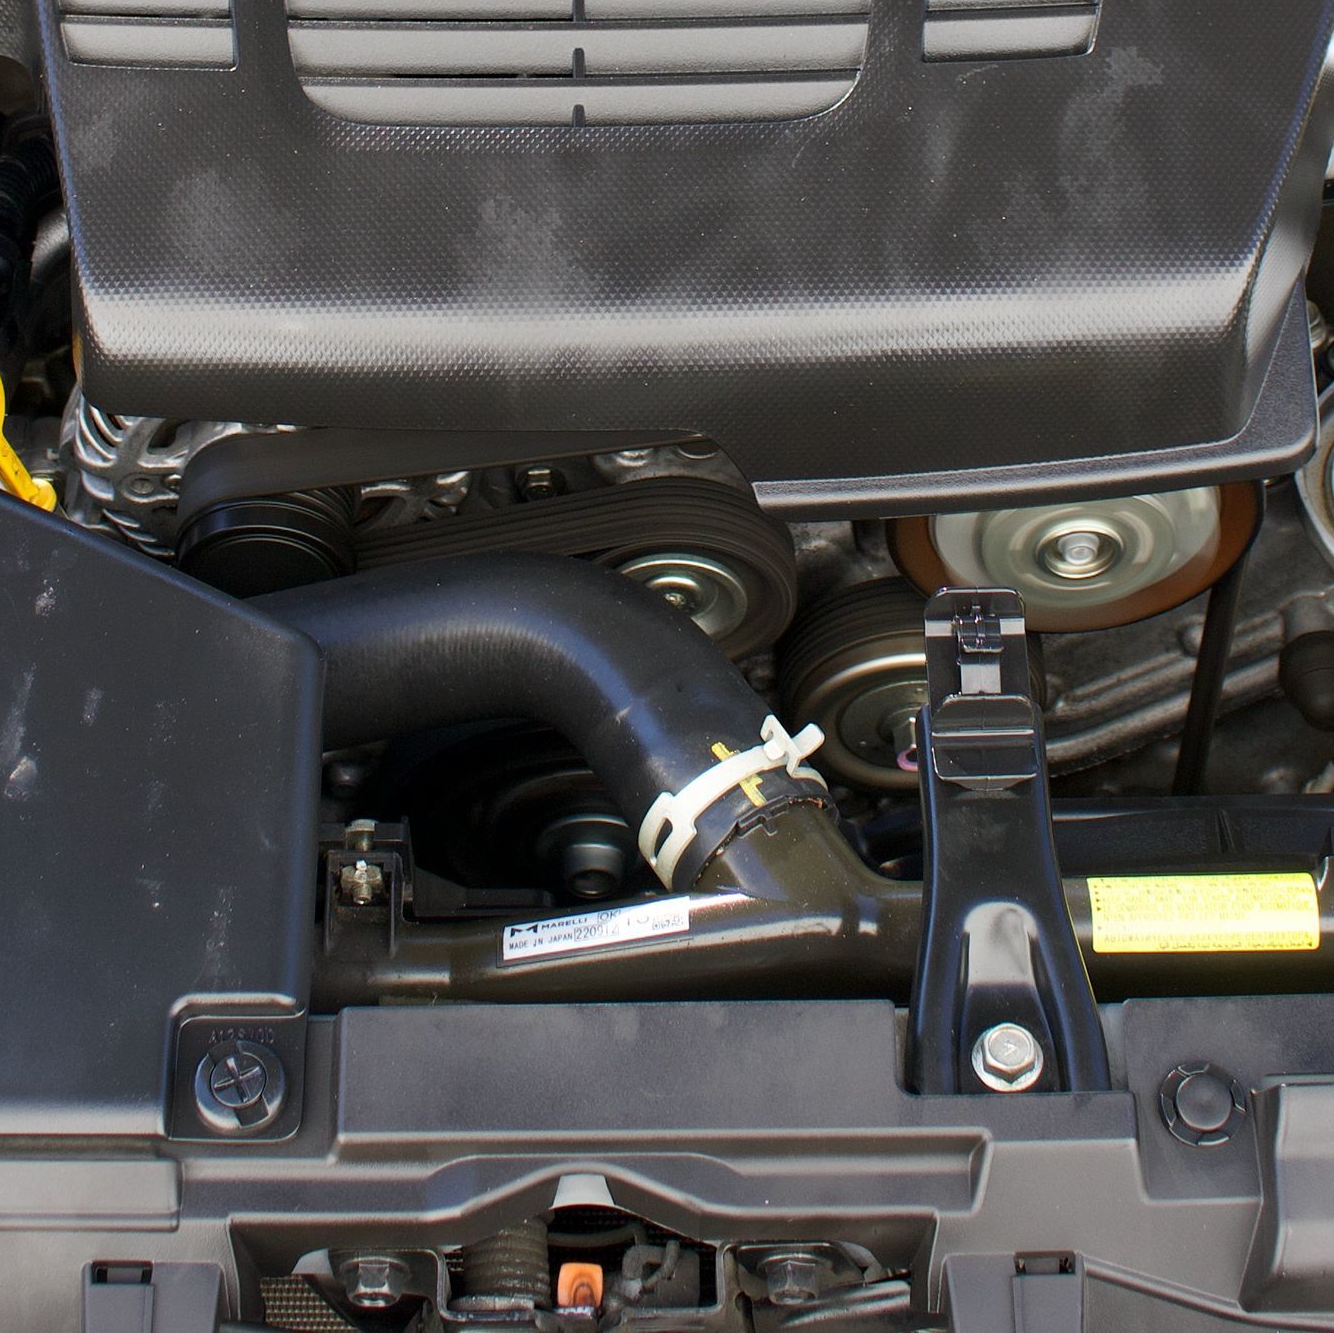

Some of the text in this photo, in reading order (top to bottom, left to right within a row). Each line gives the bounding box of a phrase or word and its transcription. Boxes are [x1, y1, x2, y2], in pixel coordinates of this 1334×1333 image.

[540, 916, 588, 931] MARELLI
[508, 933, 573, 951] MADE IN JAPAN
